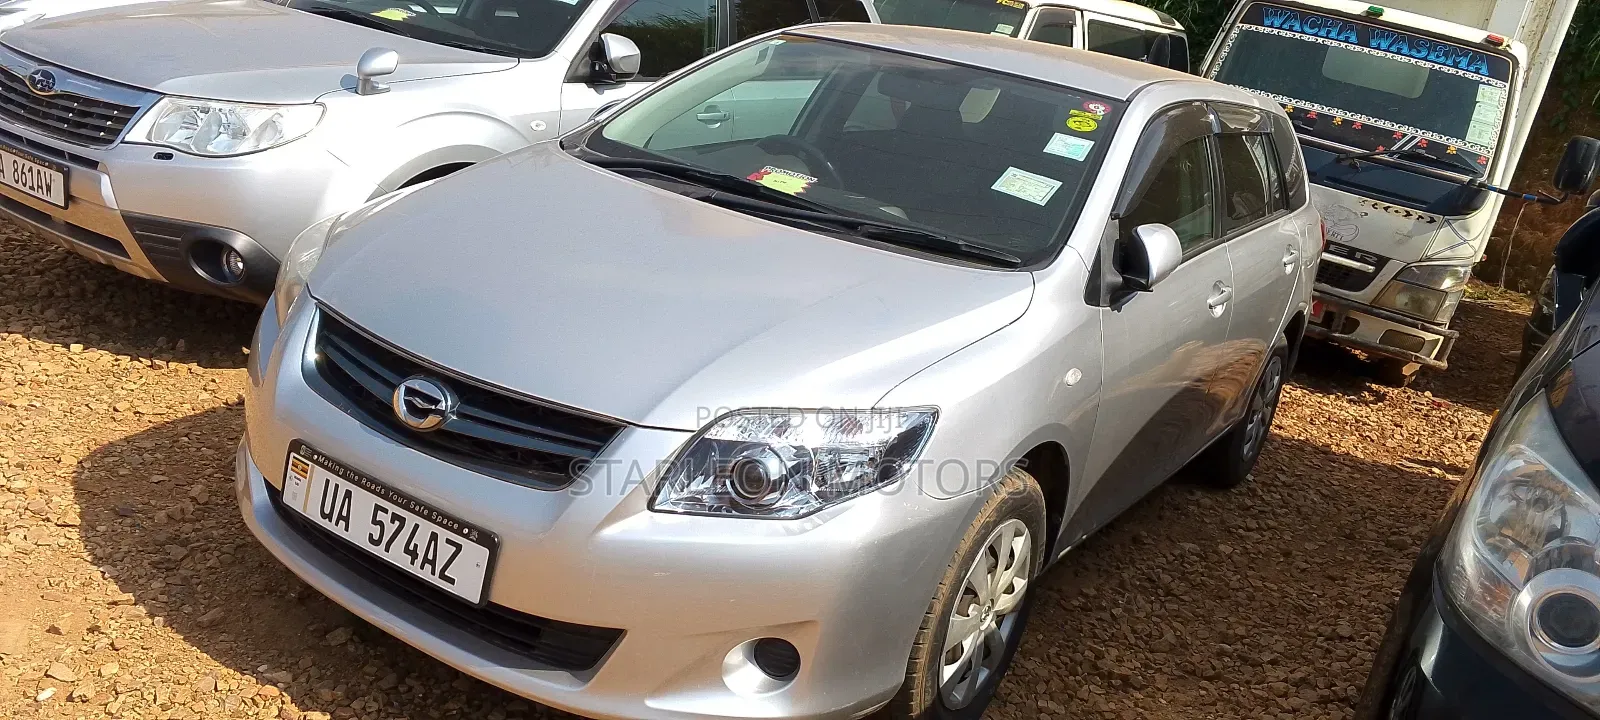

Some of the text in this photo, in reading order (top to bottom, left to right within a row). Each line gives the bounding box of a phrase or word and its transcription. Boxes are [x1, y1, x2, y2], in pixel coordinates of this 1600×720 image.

[1262, 7, 1489, 76] WACHA WASEMA
[12, 159, 53, 199] 861AW
[318, 454, 460, 531] Making the Roads Your Safe Space
[319, 477, 463, 587] UA 574AZ
